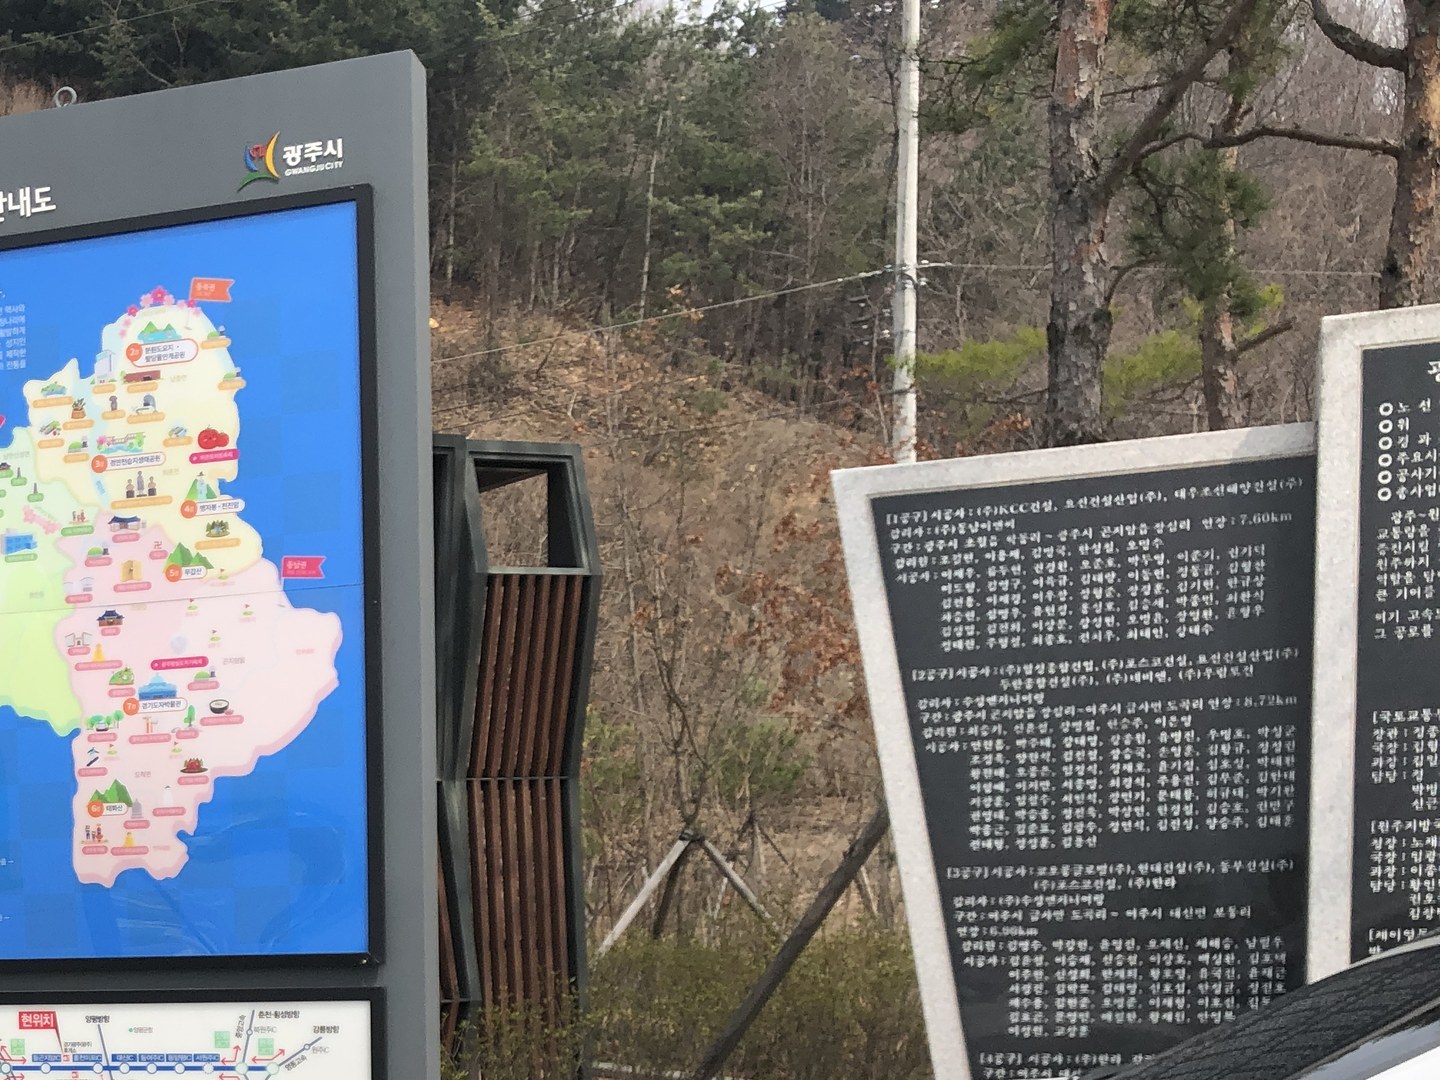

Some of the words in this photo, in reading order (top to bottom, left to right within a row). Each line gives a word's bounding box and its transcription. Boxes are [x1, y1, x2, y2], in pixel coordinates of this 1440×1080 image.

[283, 138, 343, 166] 광주시
[21, 1012, 54, 1028] 현위치
[85, 1015, 110, 1024] 양평방향
